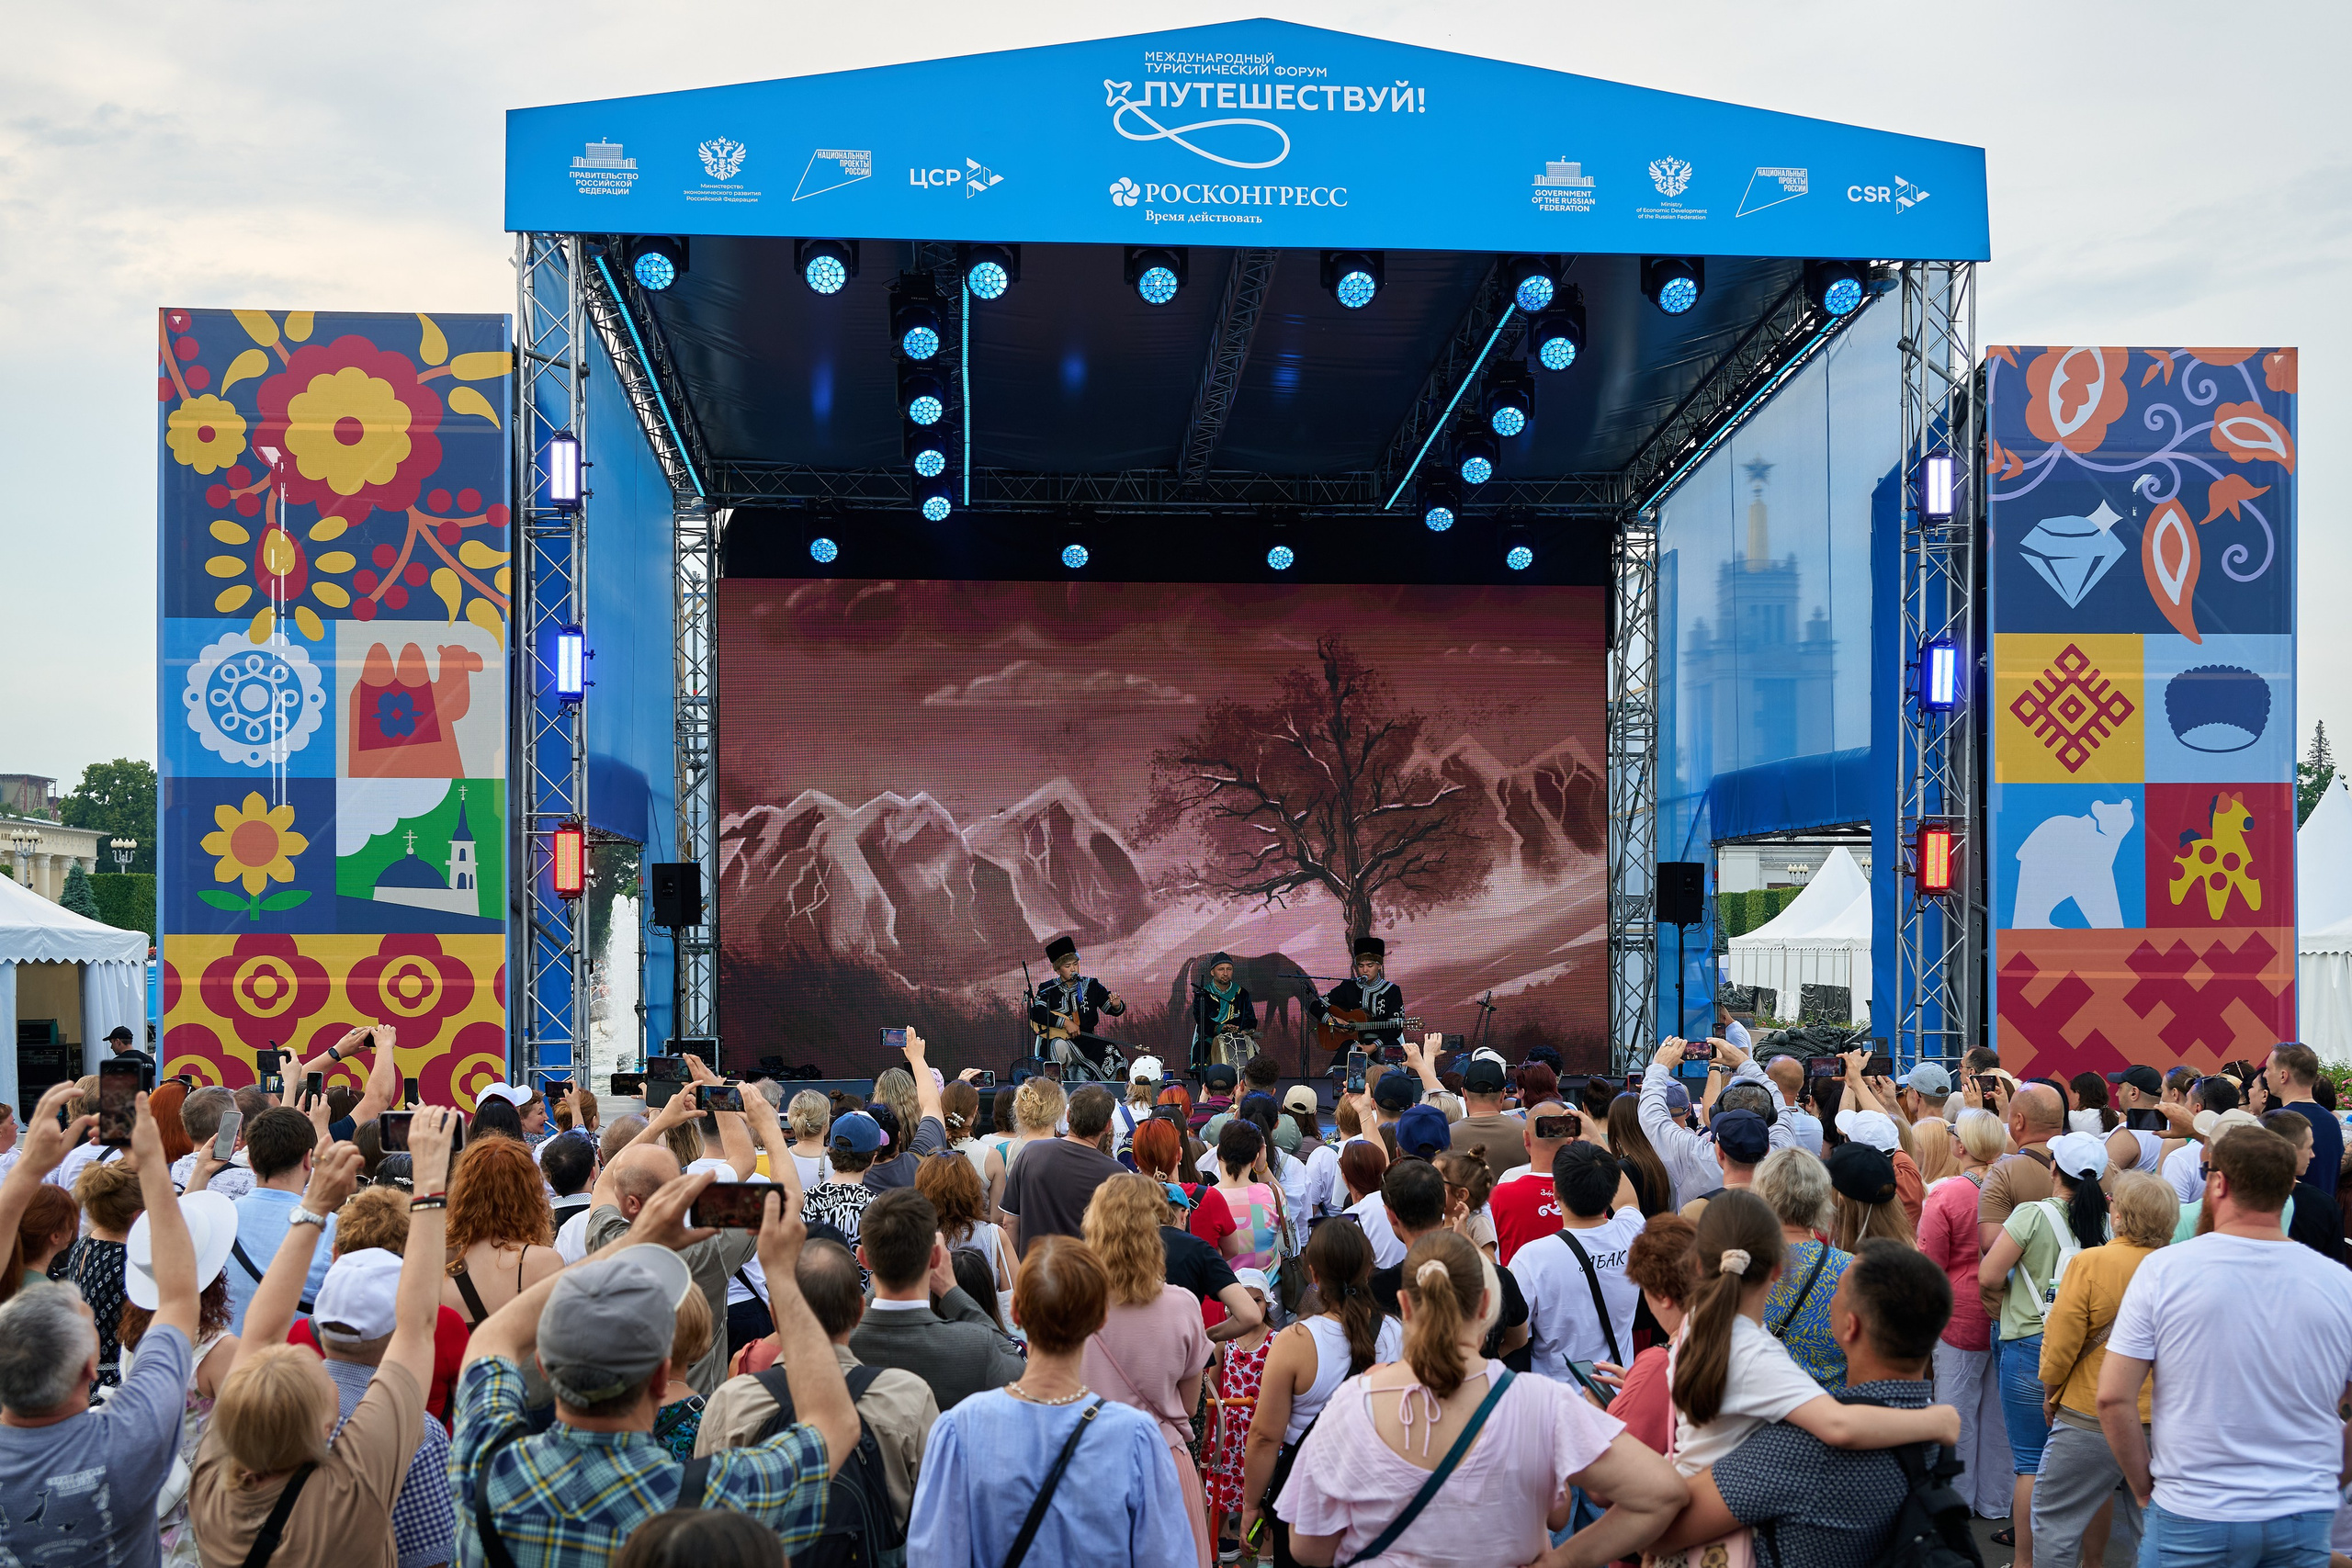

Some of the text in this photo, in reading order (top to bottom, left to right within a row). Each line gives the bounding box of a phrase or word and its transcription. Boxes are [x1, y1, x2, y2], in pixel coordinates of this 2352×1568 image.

[1145, 51, 1274, 65] МЕЖДУНАРОДНЫЙ
[1145, 62, 1328, 77] ТУРИСТИЧЕСКИЙ ФОРУМ
[1145, 80, 1425, 113] ПУТЕШЕСТВУЙ!
[817, 151, 870, 160] НАЦИОНАЛЬНЫЕ
[569, 171, 639, 180] ПРАВИТЕЛЬСТВО
[844, 167, 870, 175] РОССИИ
[1758, 169, 1806, 177] НАЦИОНАЛЬНЫЕ
[575, 179, 633, 187] РОССИЙСКОЙ
[910, 168, 962, 189] ЦСР
[1778, 176, 1806, 185] ПРОЕКТЫ
[578, 187, 629, 196] ФЕДЕРАЦИИ
[1534, 189, 1592, 197] GOVERNMENT
[1783, 185, 1806, 193] РОССИИ
[1145, 183, 1348, 207] РОСКОНГРЕСС
[1847, 185, 1891, 203] CSR
[1539, 204, 1589, 212] FEDERATION
[1145, 209, 1262, 225] Время действовать
